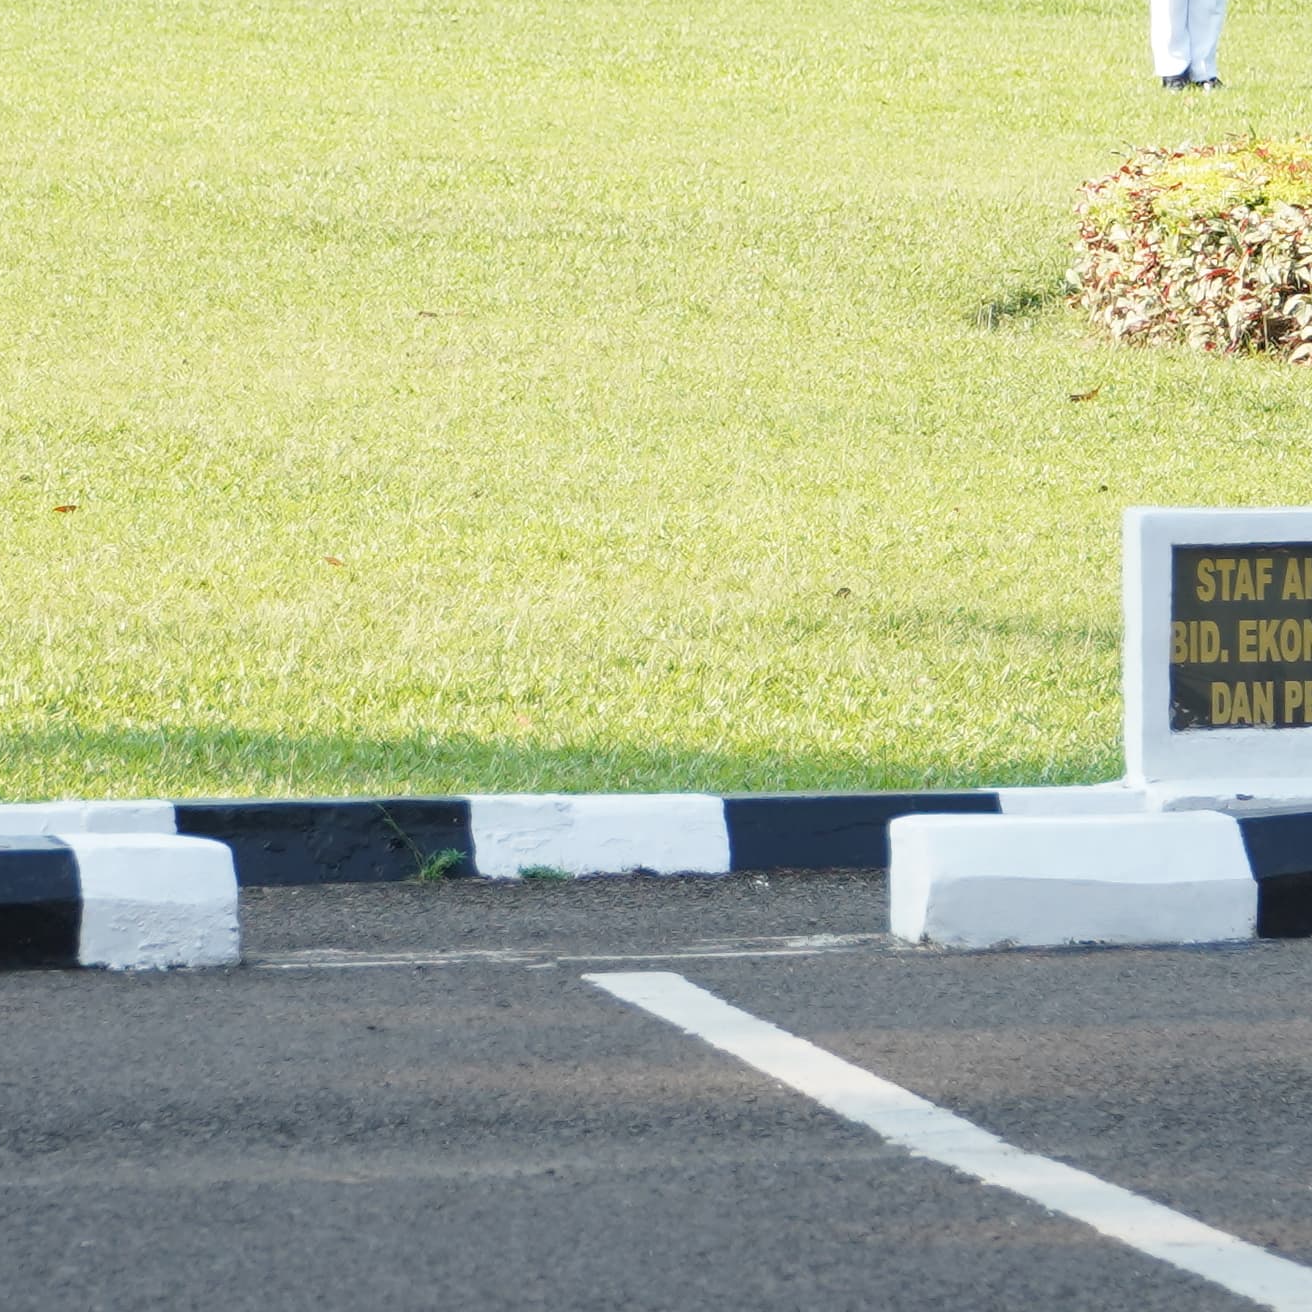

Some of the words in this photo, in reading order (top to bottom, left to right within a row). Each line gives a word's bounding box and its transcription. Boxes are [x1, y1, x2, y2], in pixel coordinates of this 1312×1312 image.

[1196, 557, 1273, 602] STAF
[1170, 619, 1229, 664] BID.
[1211, 681, 1274, 725] DAN
